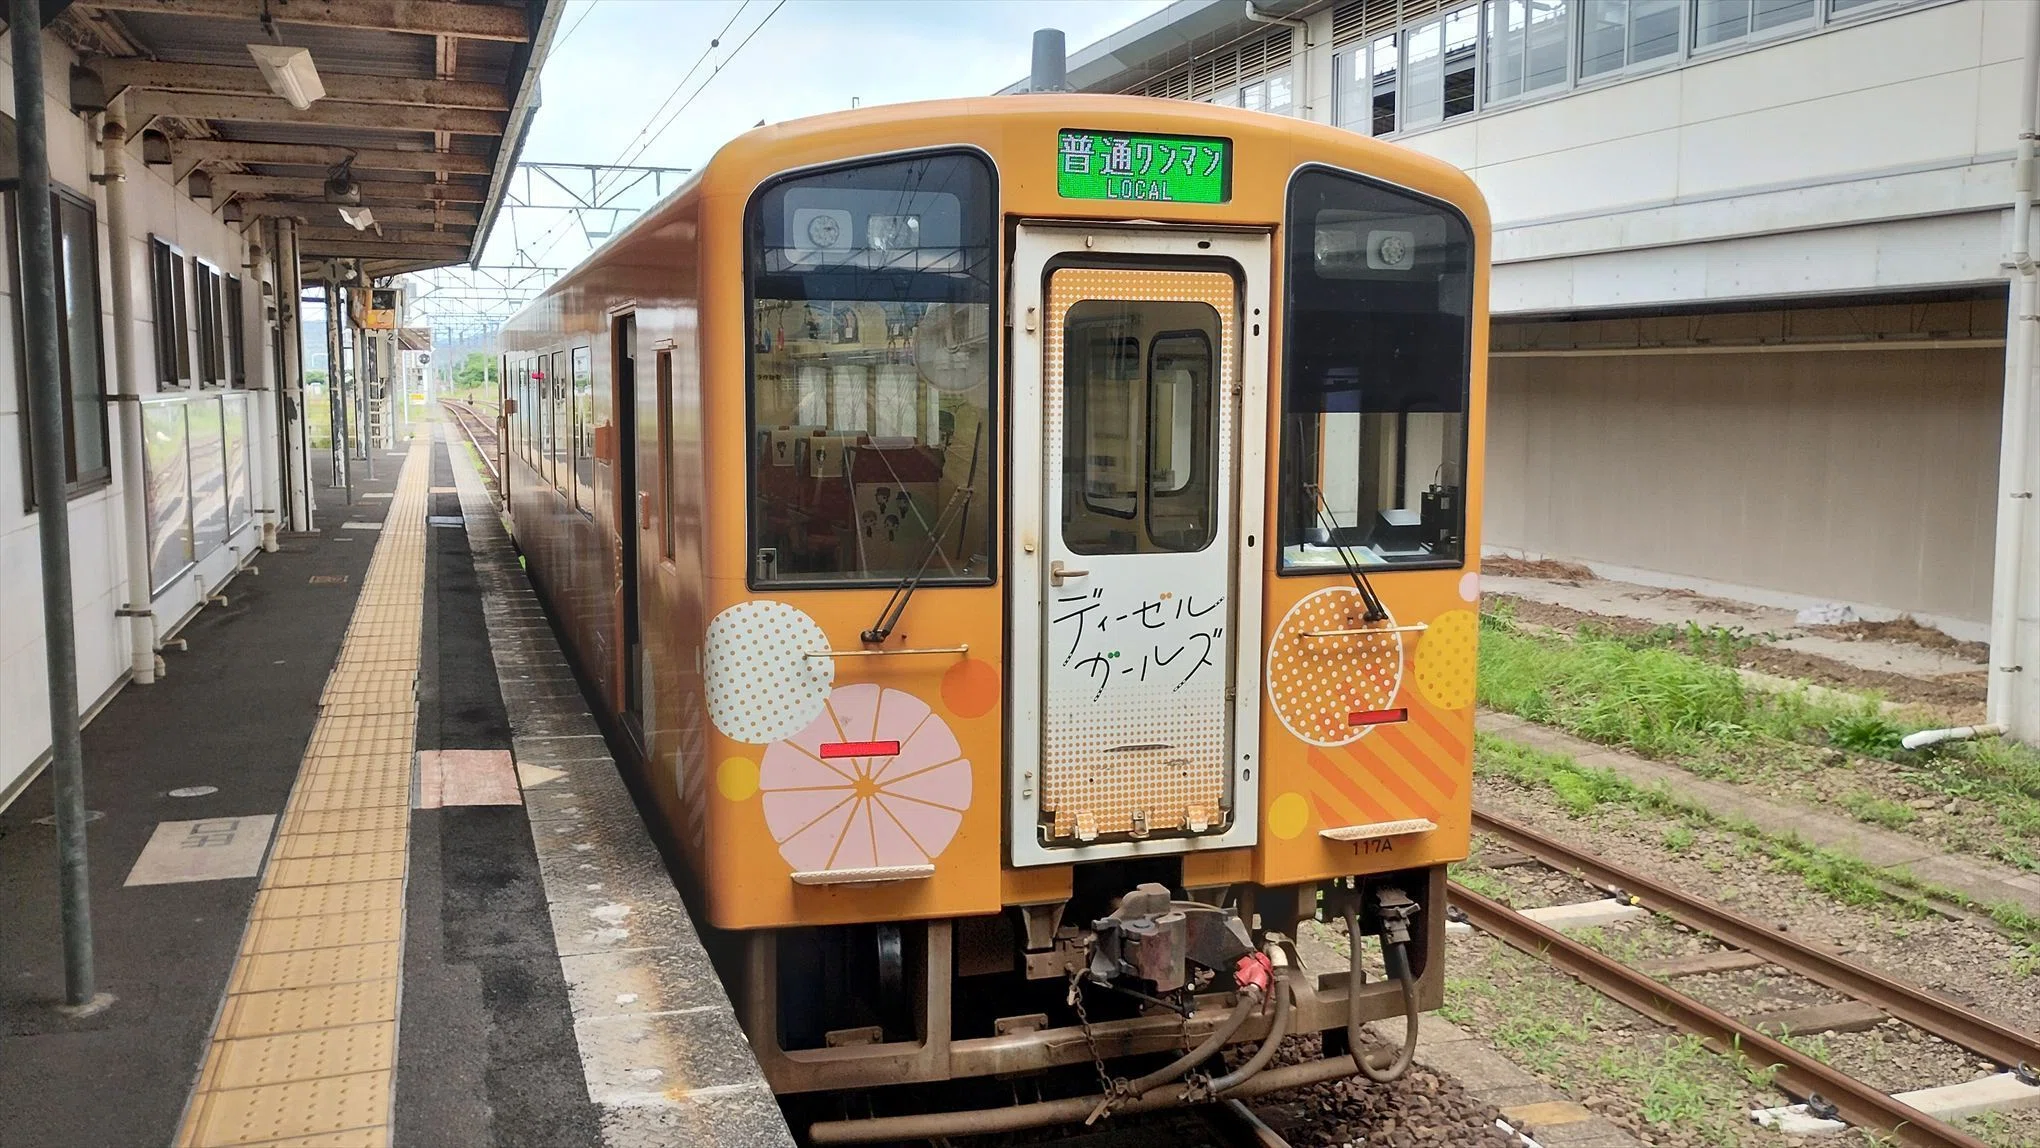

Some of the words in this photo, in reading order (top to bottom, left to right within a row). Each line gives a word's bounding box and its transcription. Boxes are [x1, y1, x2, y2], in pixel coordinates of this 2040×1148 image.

[1107, 179, 1172, 200] LOCAL
[387, 333, 394, 341] 2
[1053, 588, 1225, 667] ディーゼル
[1074, 628, 1223, 703] ガールズ
[1353, 839, 1393, 856] 117A
